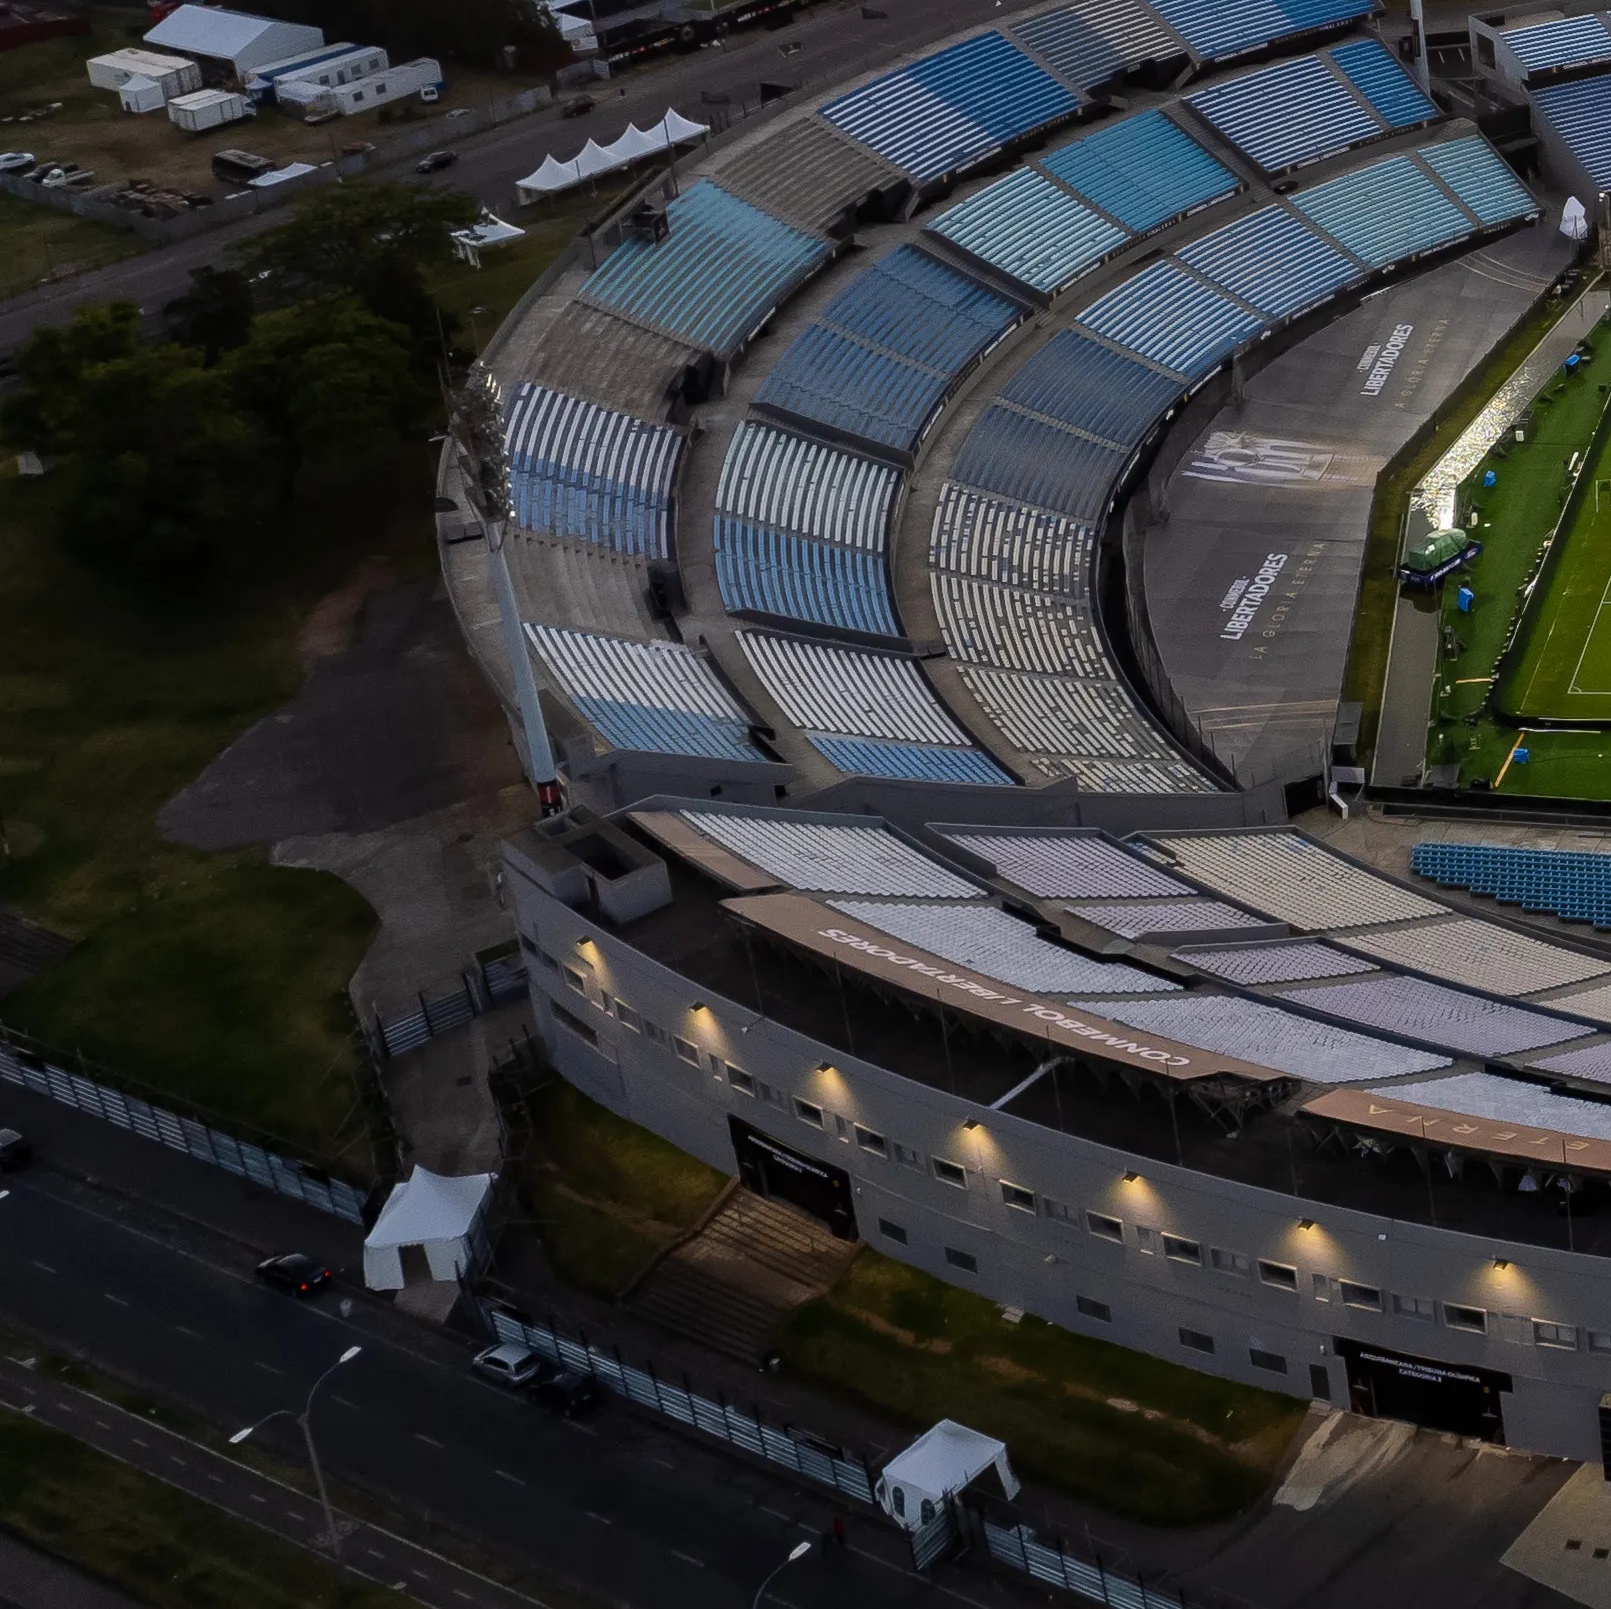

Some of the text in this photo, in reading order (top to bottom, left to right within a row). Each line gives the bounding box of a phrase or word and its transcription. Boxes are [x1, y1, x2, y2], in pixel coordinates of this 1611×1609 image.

[1360, 323, 1414, 397] LIBERTADORES
[1220, 552, 1288, 641] LIBERTADORES
[816, 926, 1192, 1069] CONMEBOL LIBERTADORES
[1364, 1102, 1591, 1152] ETERNA
